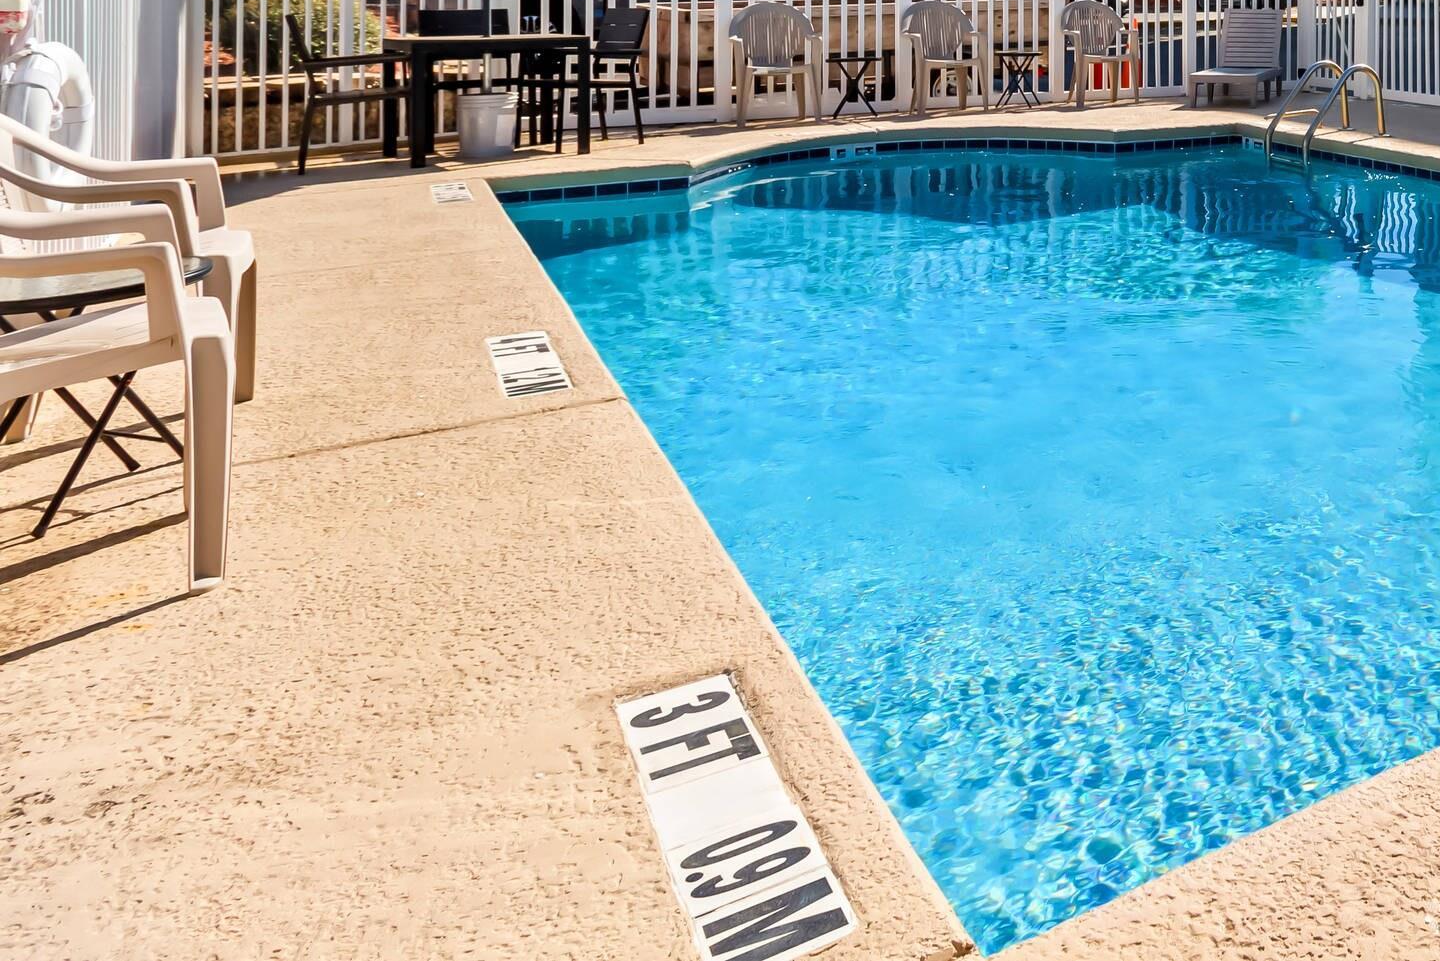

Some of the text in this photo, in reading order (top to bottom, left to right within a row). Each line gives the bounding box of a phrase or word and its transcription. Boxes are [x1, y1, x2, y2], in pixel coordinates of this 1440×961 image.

[492, 343, 550, 357] FT
[630, 691, 731, 728] 3
[639, 717, 761, 781] FT
